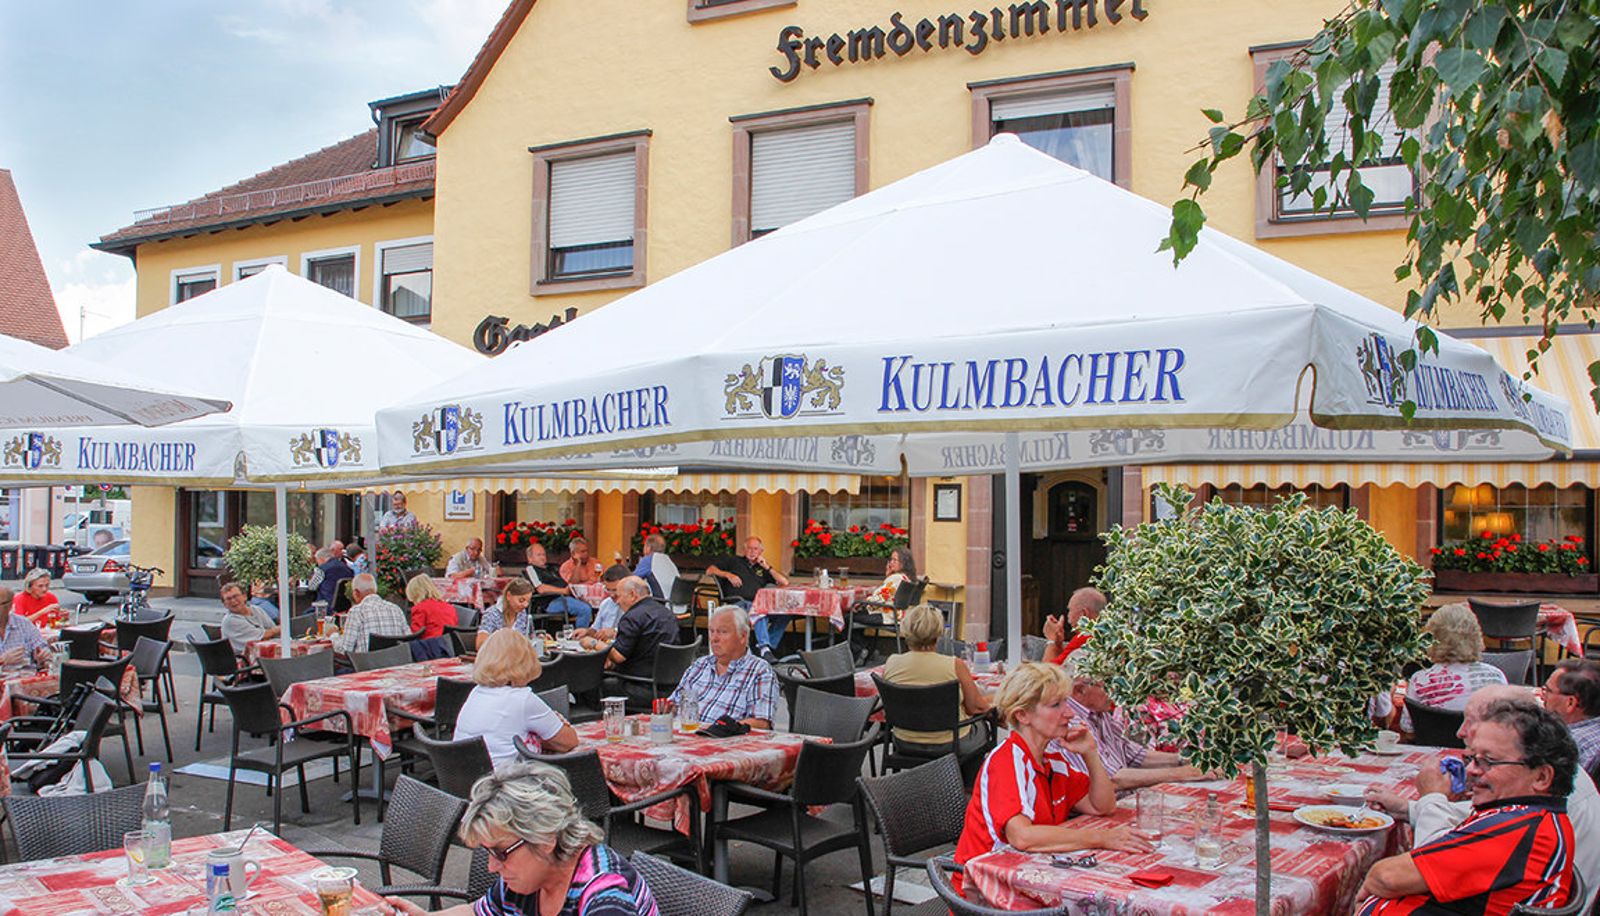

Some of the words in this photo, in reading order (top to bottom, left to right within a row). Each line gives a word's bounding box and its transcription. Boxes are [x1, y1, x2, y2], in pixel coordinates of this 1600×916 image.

[877, 347, 1186, 413] KULMBACHER
[503, 385, 672, 446] KULMBACHER
[77, 437, 196, 472] KULMBACHER
